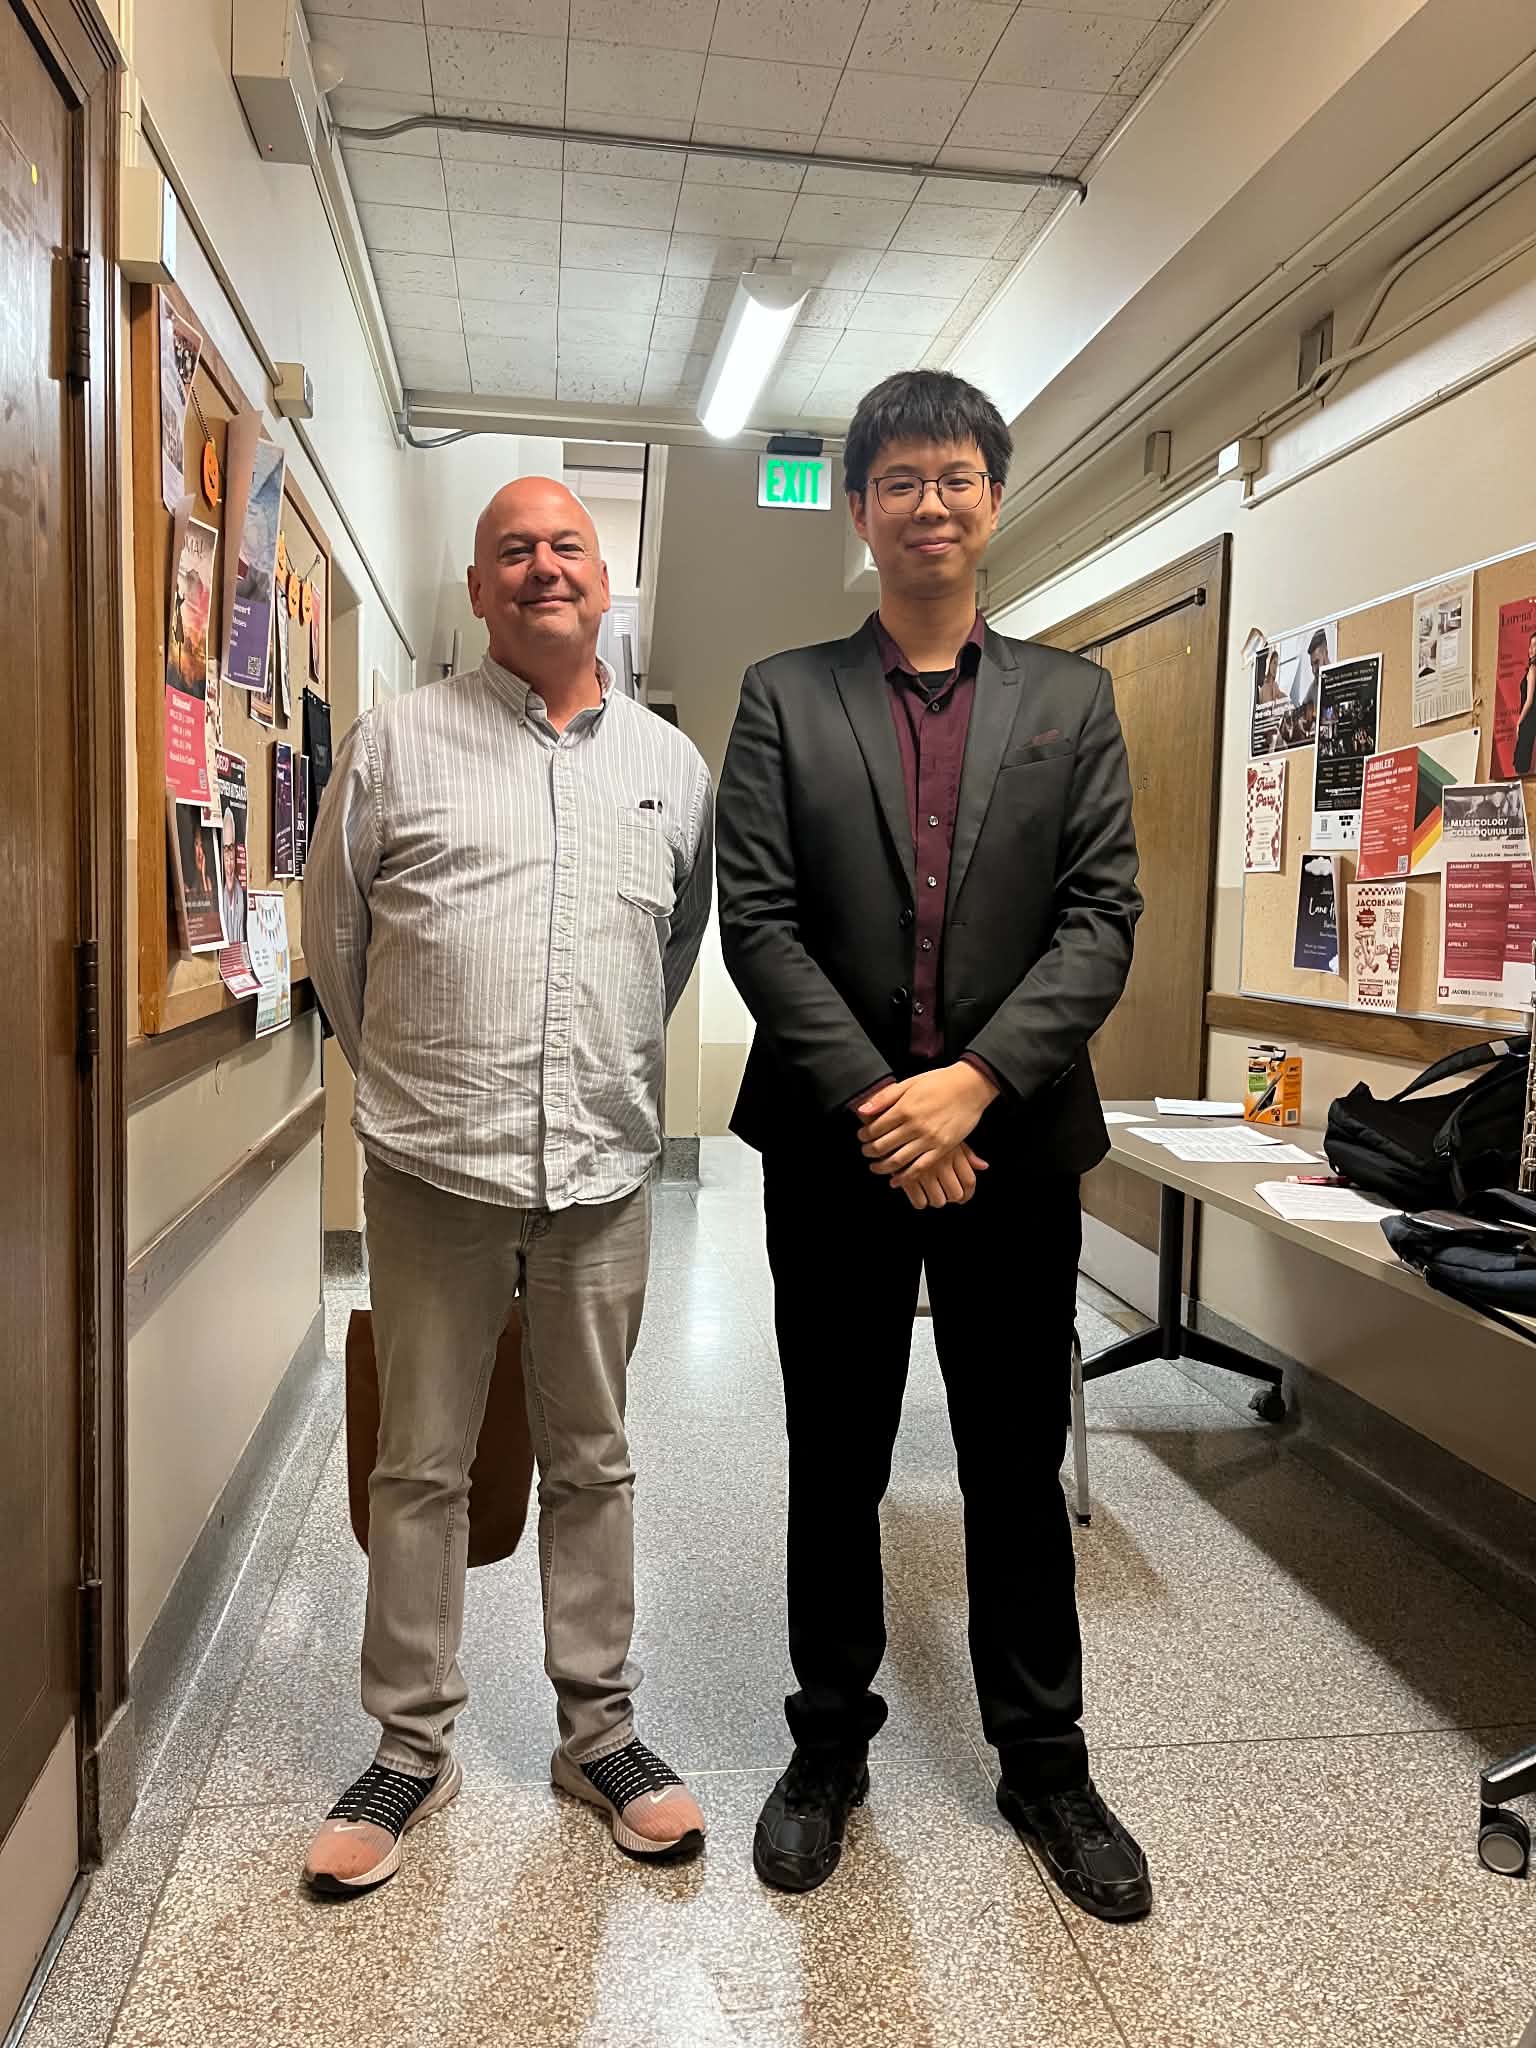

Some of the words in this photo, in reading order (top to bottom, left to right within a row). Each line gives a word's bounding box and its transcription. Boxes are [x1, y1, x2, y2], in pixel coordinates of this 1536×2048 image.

[767, 459, 824, 504] EXIT
[1255, 793, 1276, 810] Party
[1450, 818, 1508, 827] MUSICOLOGY
[1451, 828, 1507, 837] COLLOQUIUM
[1356, 899, 1385, 907] JACOBS
